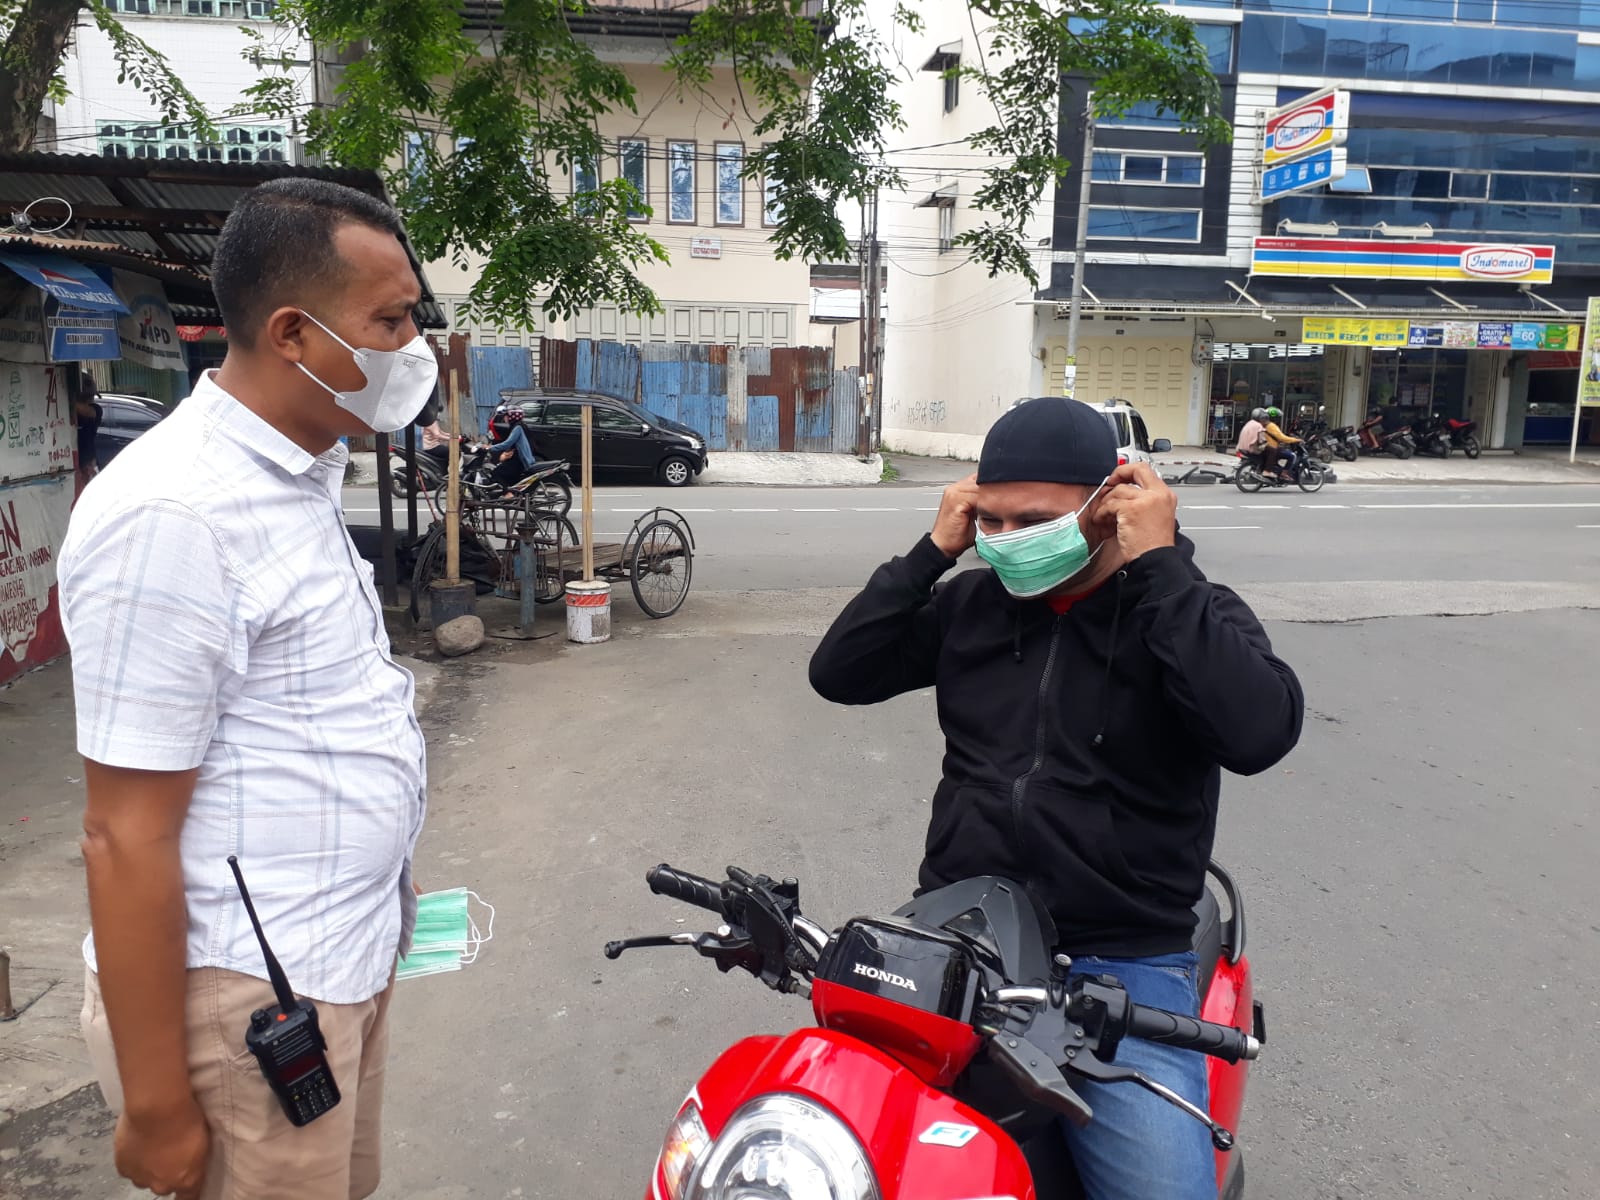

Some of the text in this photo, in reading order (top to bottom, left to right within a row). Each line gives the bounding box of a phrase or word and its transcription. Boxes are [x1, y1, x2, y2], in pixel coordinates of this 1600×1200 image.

[1277, 114, 1322, 145] Indomaret
[1470, 254, 1529, 269] Indomaret
[1410, 335, 1425, 344] BCA
[1521, 331, 1535, 342] 60
[853, 963, 918, 992] HONDA
